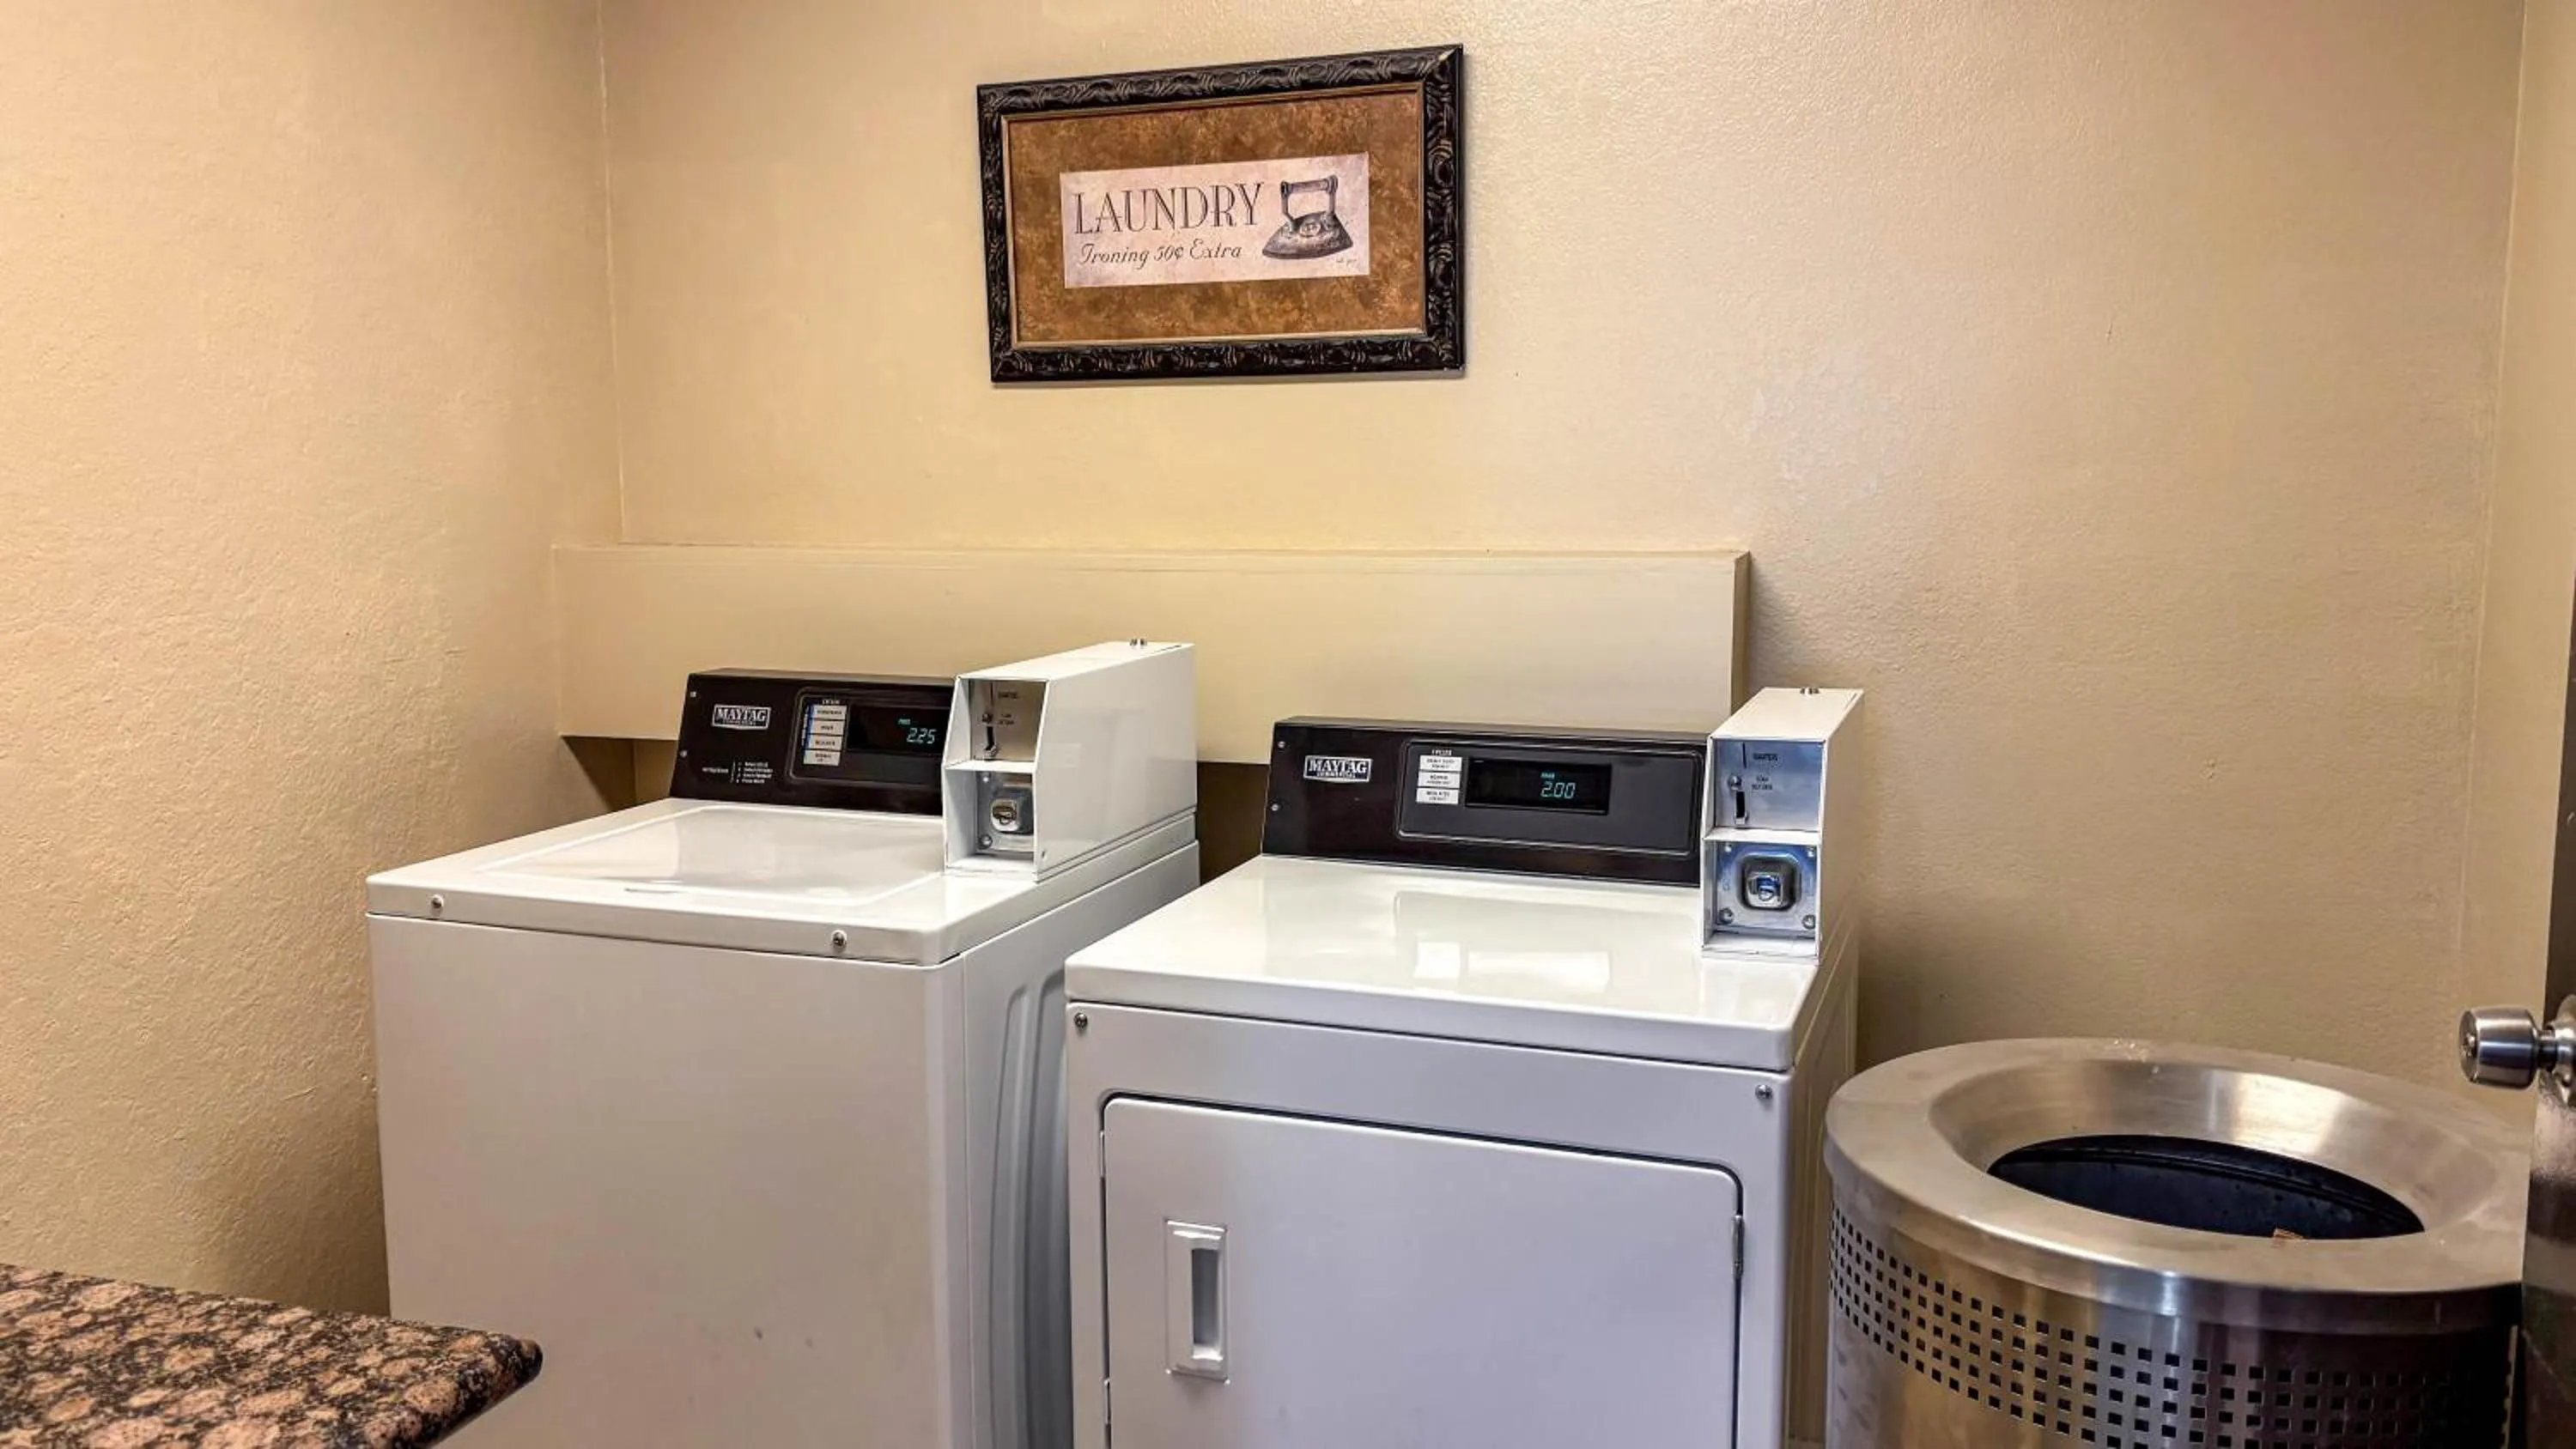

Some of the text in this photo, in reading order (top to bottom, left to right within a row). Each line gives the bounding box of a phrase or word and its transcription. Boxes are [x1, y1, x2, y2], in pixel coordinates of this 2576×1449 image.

[1074, 182, 1264, 234] LAUNDRY
[1080, 242, 1150, 270] Ironing
[1190, 238, 1242, 259] Extra
[716, 708, 767, 722] MAYTAG
[1309, 759, 1368, 773] MAYTAG
